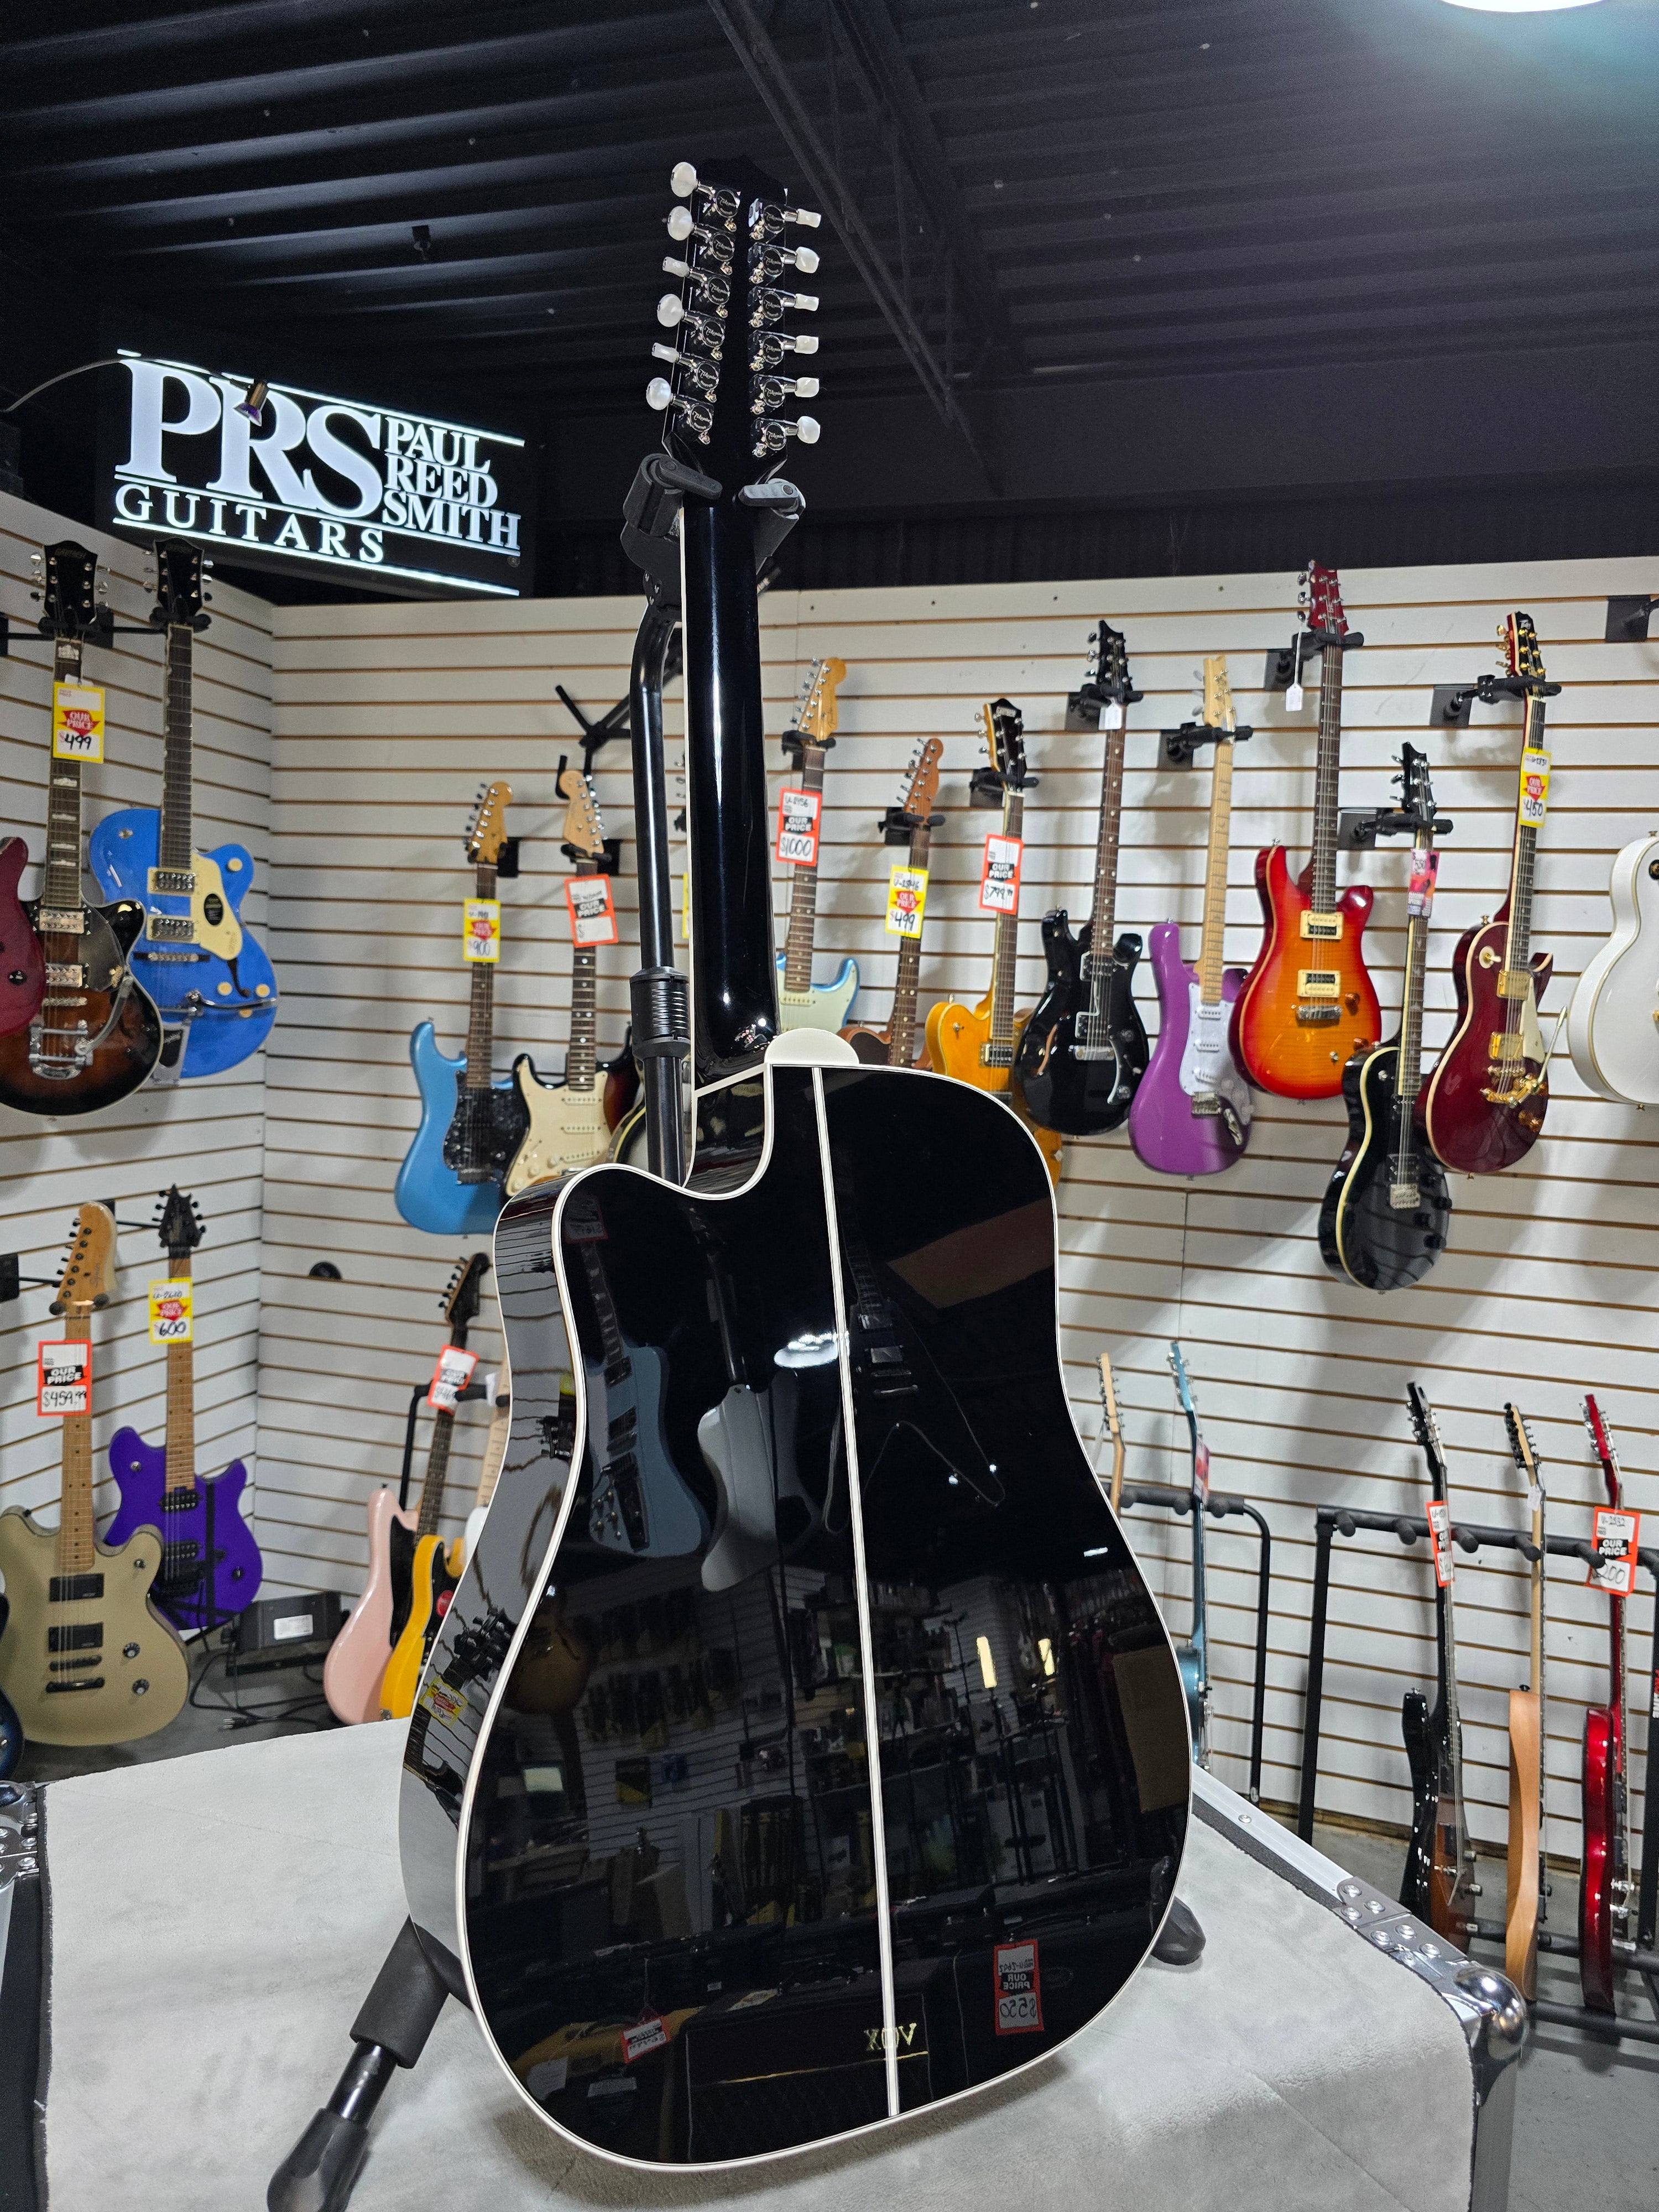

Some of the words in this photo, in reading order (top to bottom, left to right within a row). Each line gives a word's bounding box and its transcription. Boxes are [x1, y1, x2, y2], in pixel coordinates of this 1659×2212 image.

[116, 359, 383, 518] PRS
[385, 416, 492, 474] PAUL
[385, 453, 498, 508] REED
[115, 485, 385, 564] GUITARS
[382, 491, 521, 551] SMITH
[70, 712, 90, 720] OUR
[66, 719, 93, 730] PRICE
[992, 863, 1010, 872] OUR
[51, 1366, 76, 1376] OUR
[47, 1372, 82, 1385] PRICE
[1599, 1547, 1627, 1556] PRICE
